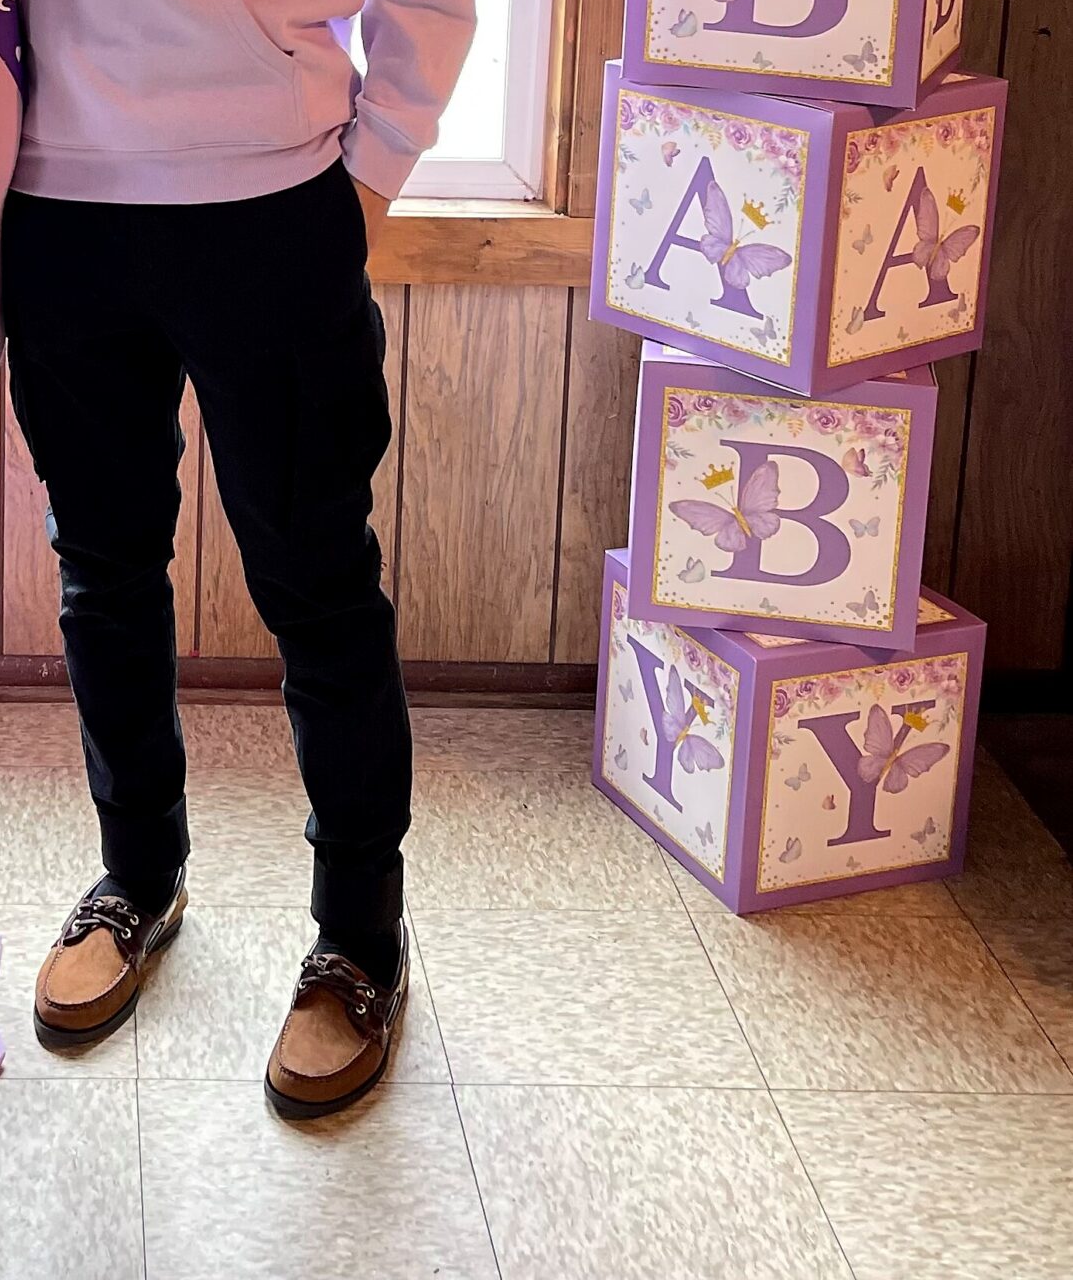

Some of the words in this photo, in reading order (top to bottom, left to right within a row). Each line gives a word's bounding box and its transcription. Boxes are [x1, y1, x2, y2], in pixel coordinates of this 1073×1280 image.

[644, 156, 765, 320] A
[863, 166, 959, 321] A
[711, 438, 852, 587] B
[626, 634, 716, 813] Y
[797, 699, 936, 847] Y
